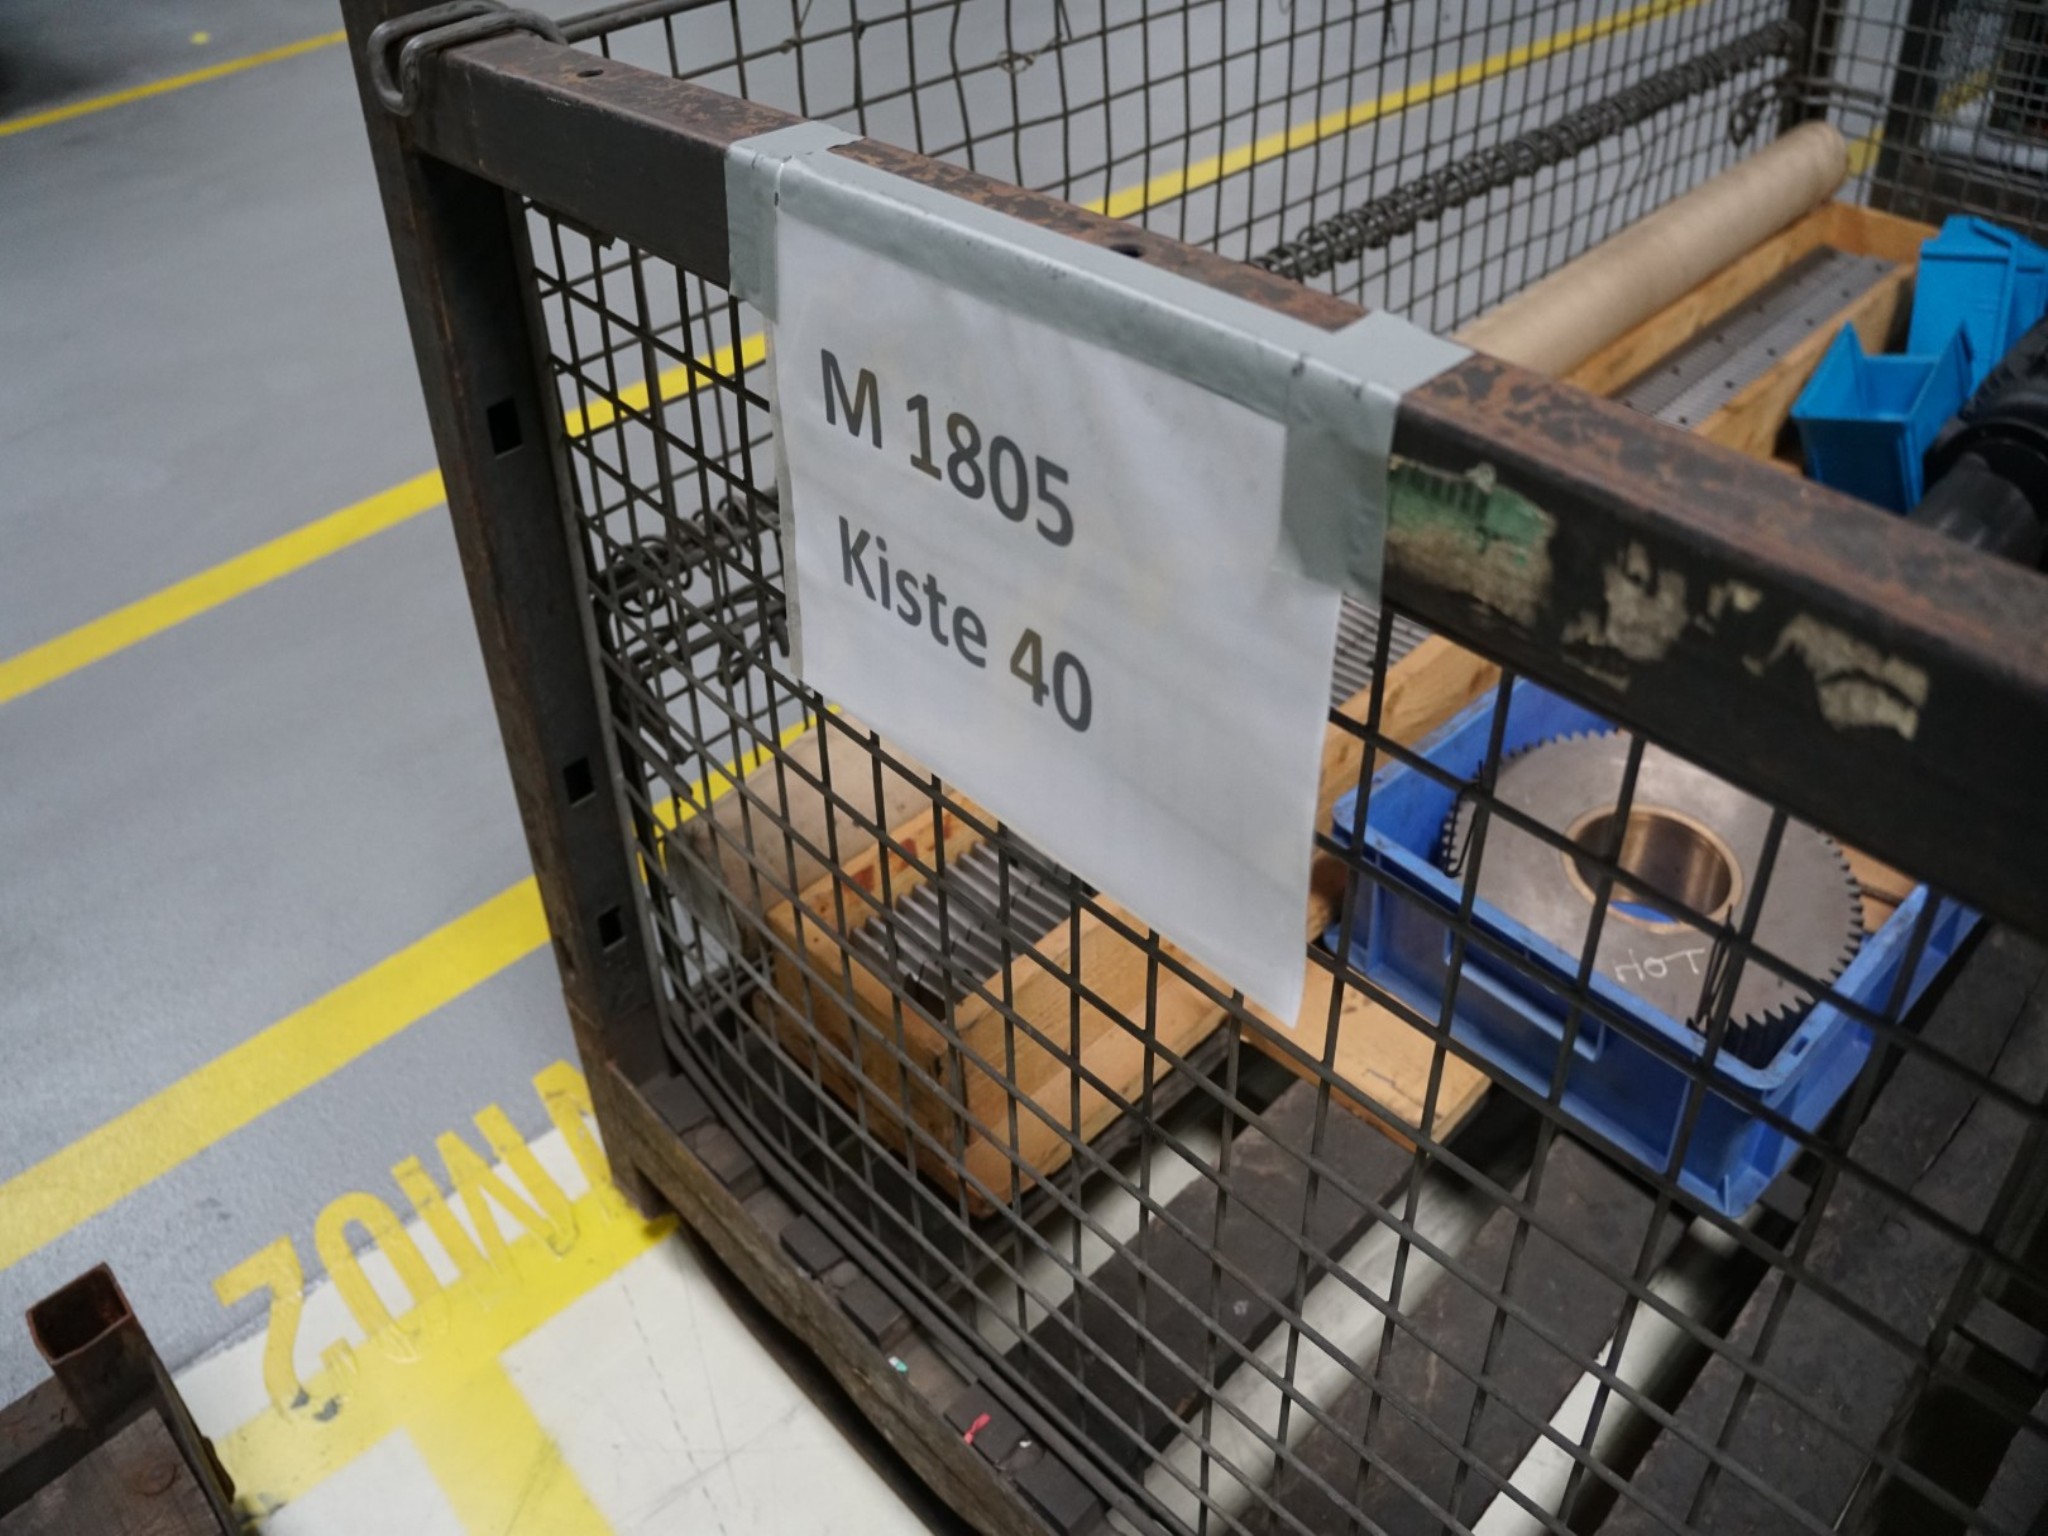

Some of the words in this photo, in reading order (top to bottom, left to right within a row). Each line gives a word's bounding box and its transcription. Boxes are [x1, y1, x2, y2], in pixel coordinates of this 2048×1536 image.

[821, 348, 882, 449] M
[906, 393, 1074, 548] 1805
[838, 515, 987, 668] Kiste
[1010, 627, 1093, 733] 40
